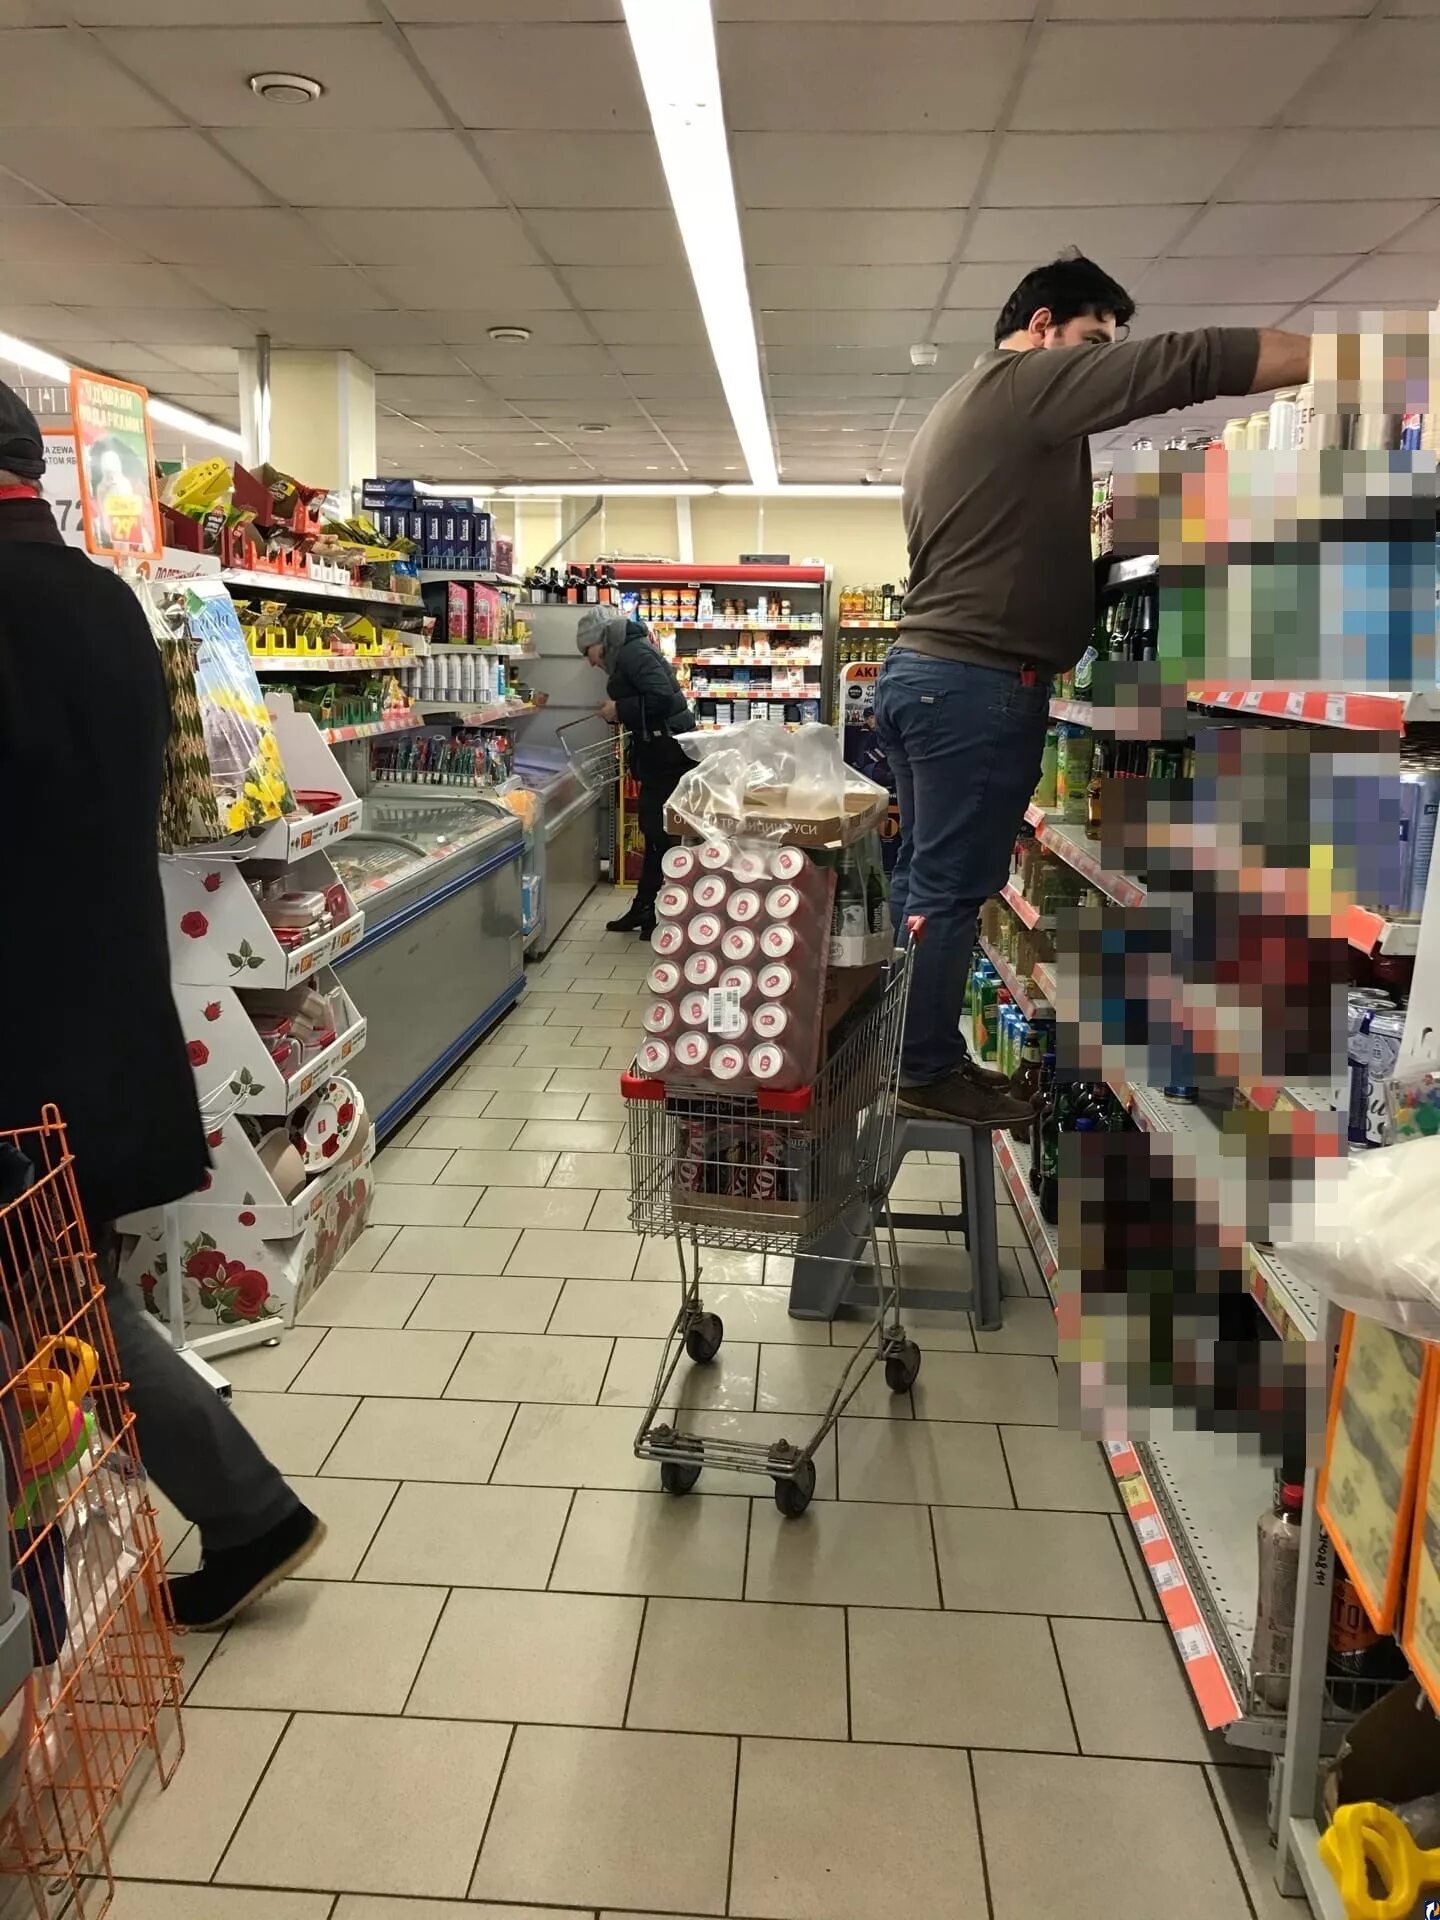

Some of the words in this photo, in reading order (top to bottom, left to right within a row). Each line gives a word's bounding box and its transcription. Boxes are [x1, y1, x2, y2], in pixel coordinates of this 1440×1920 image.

[52, 446, 74, 454] ZEWA
[44, 457, 65, 465] АТОМ
[720, 818, 783, 834] ТРИЦИИ
